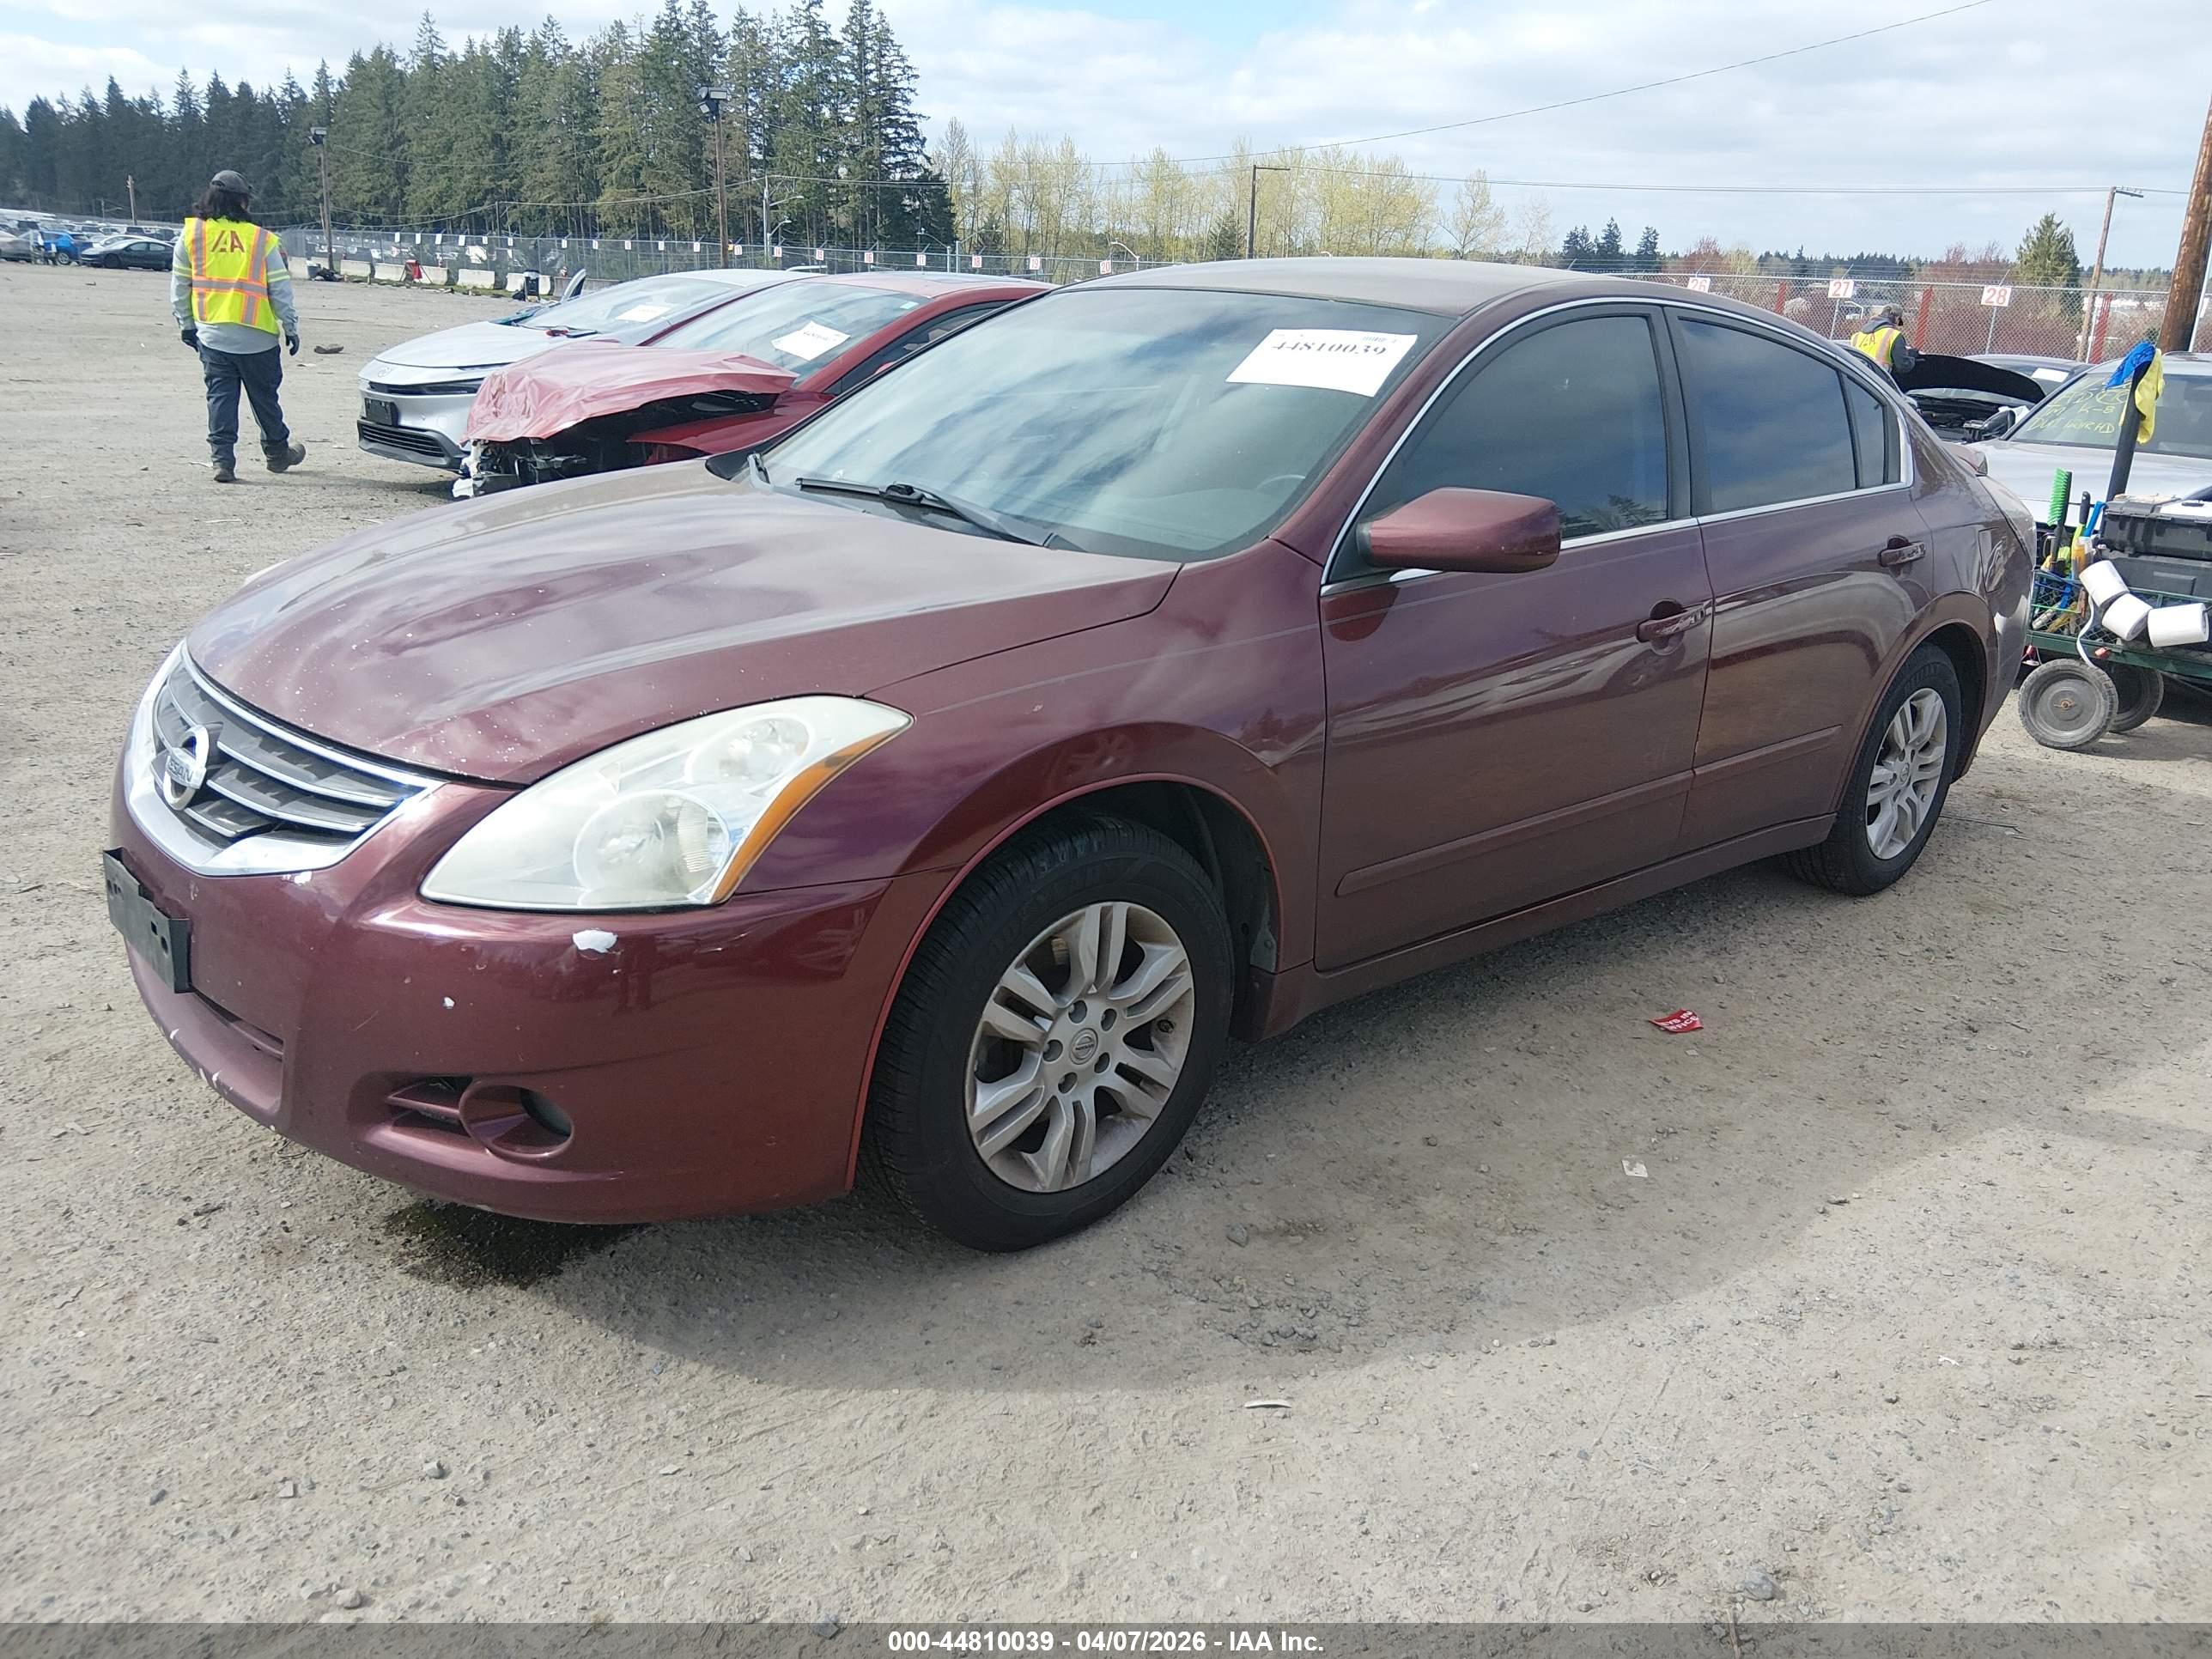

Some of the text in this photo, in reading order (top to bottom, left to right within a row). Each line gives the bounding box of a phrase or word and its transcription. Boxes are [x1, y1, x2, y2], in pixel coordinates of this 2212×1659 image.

[974, 257, 981, 267] 18
[1031, 258, 1038, 268] 19
[1102, 262, 1110, 272] 20
[1692, 279, 1707, 292] 26
[1832, 282, 1850, 296] 27
[1985, 288, 2007, 305] 28
